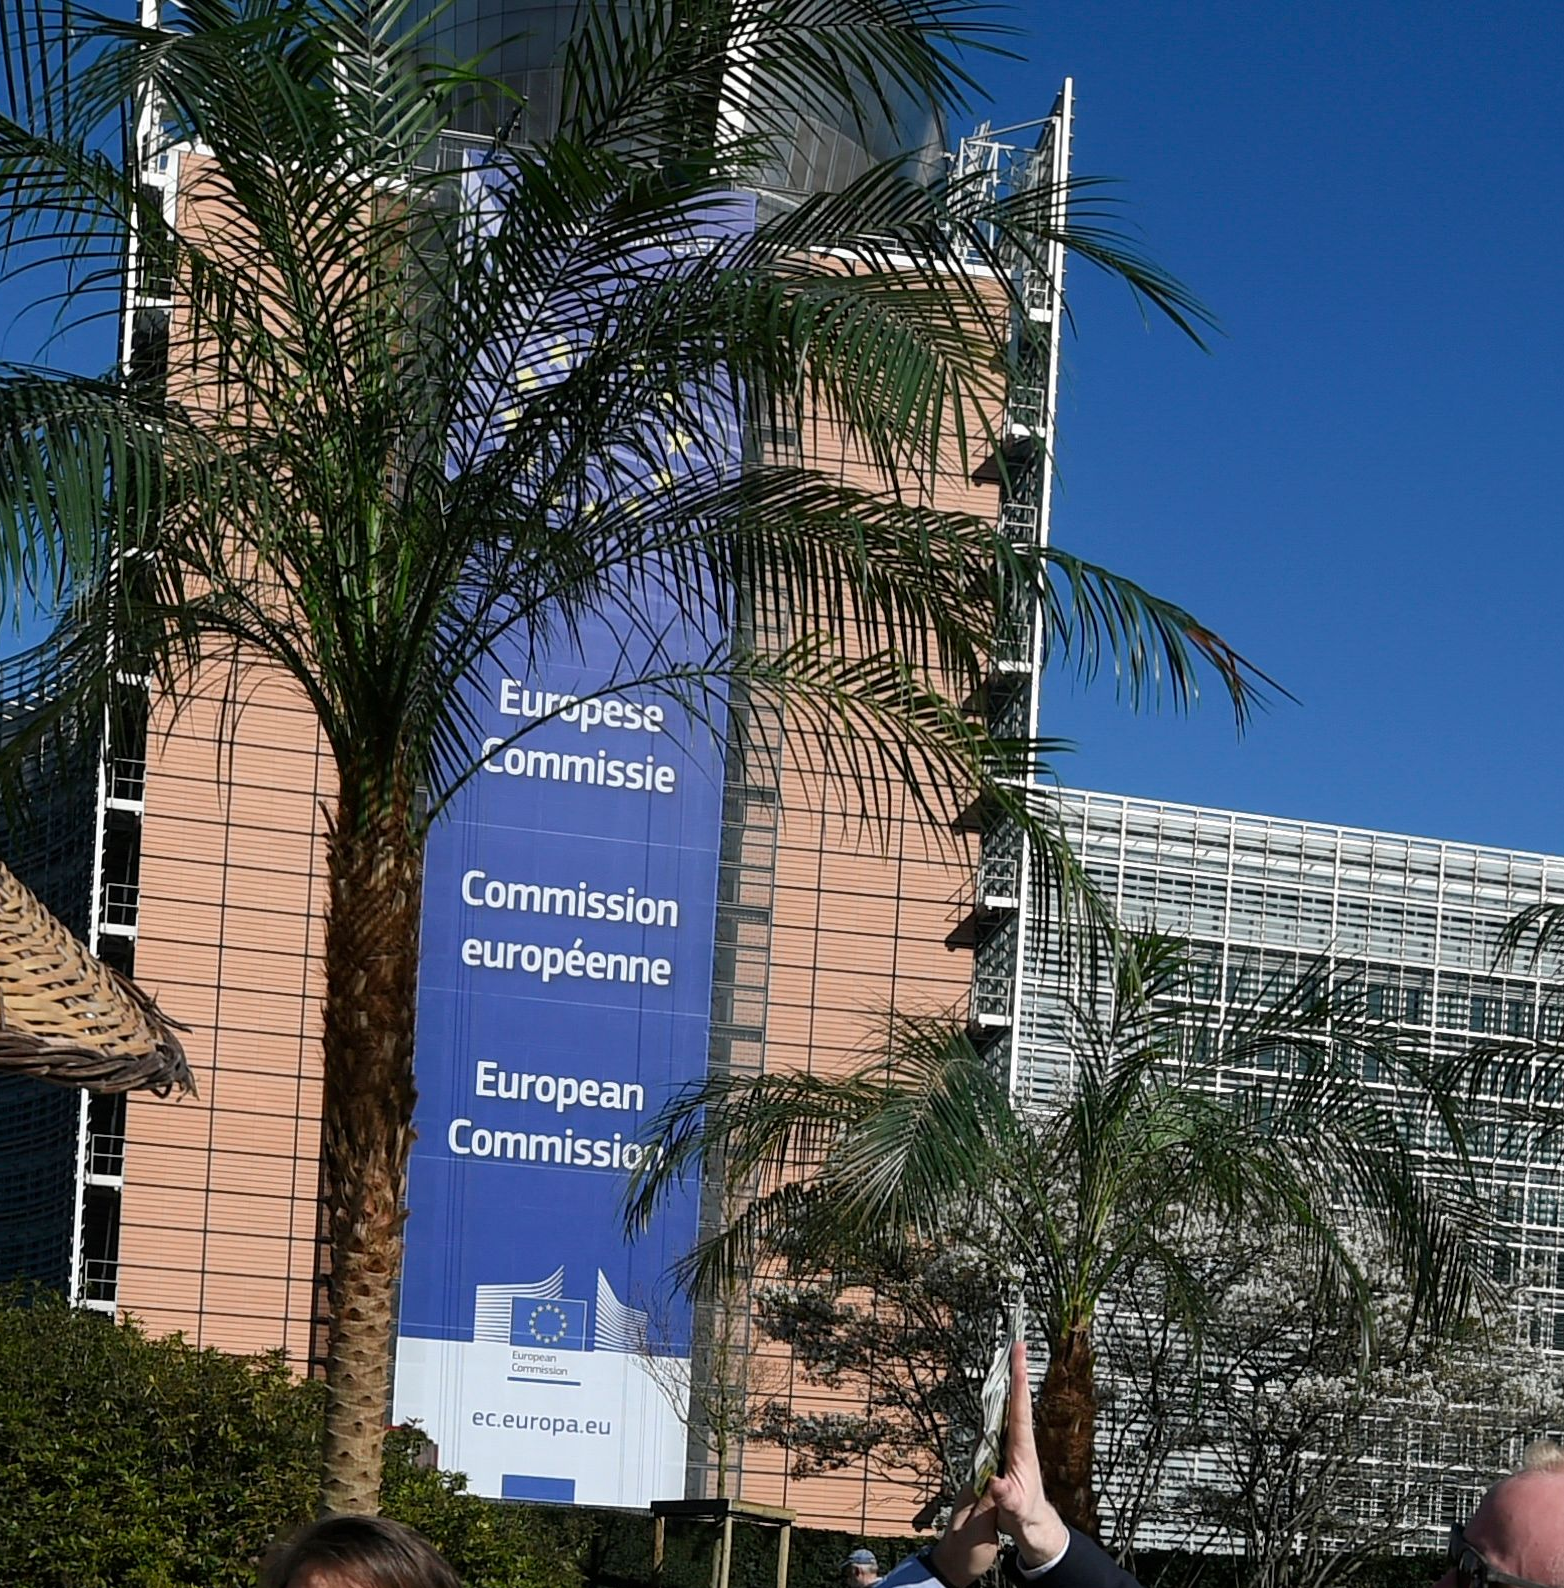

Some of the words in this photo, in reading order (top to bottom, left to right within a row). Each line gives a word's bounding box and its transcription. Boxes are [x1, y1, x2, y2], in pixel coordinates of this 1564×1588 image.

[500, 679, 663, 732] Europese
[482, 738, 674, 792] Commissie
[462, 871, 677, 926] Commission
[462, 939, 670, 984] européenne
[476, 1061, 643, 1112] European
[512, 1351, 557, 1363] European
[512, 1363, 568, 1375] Commission
[472, 1411, 611, 1437] ec.europa.eu
